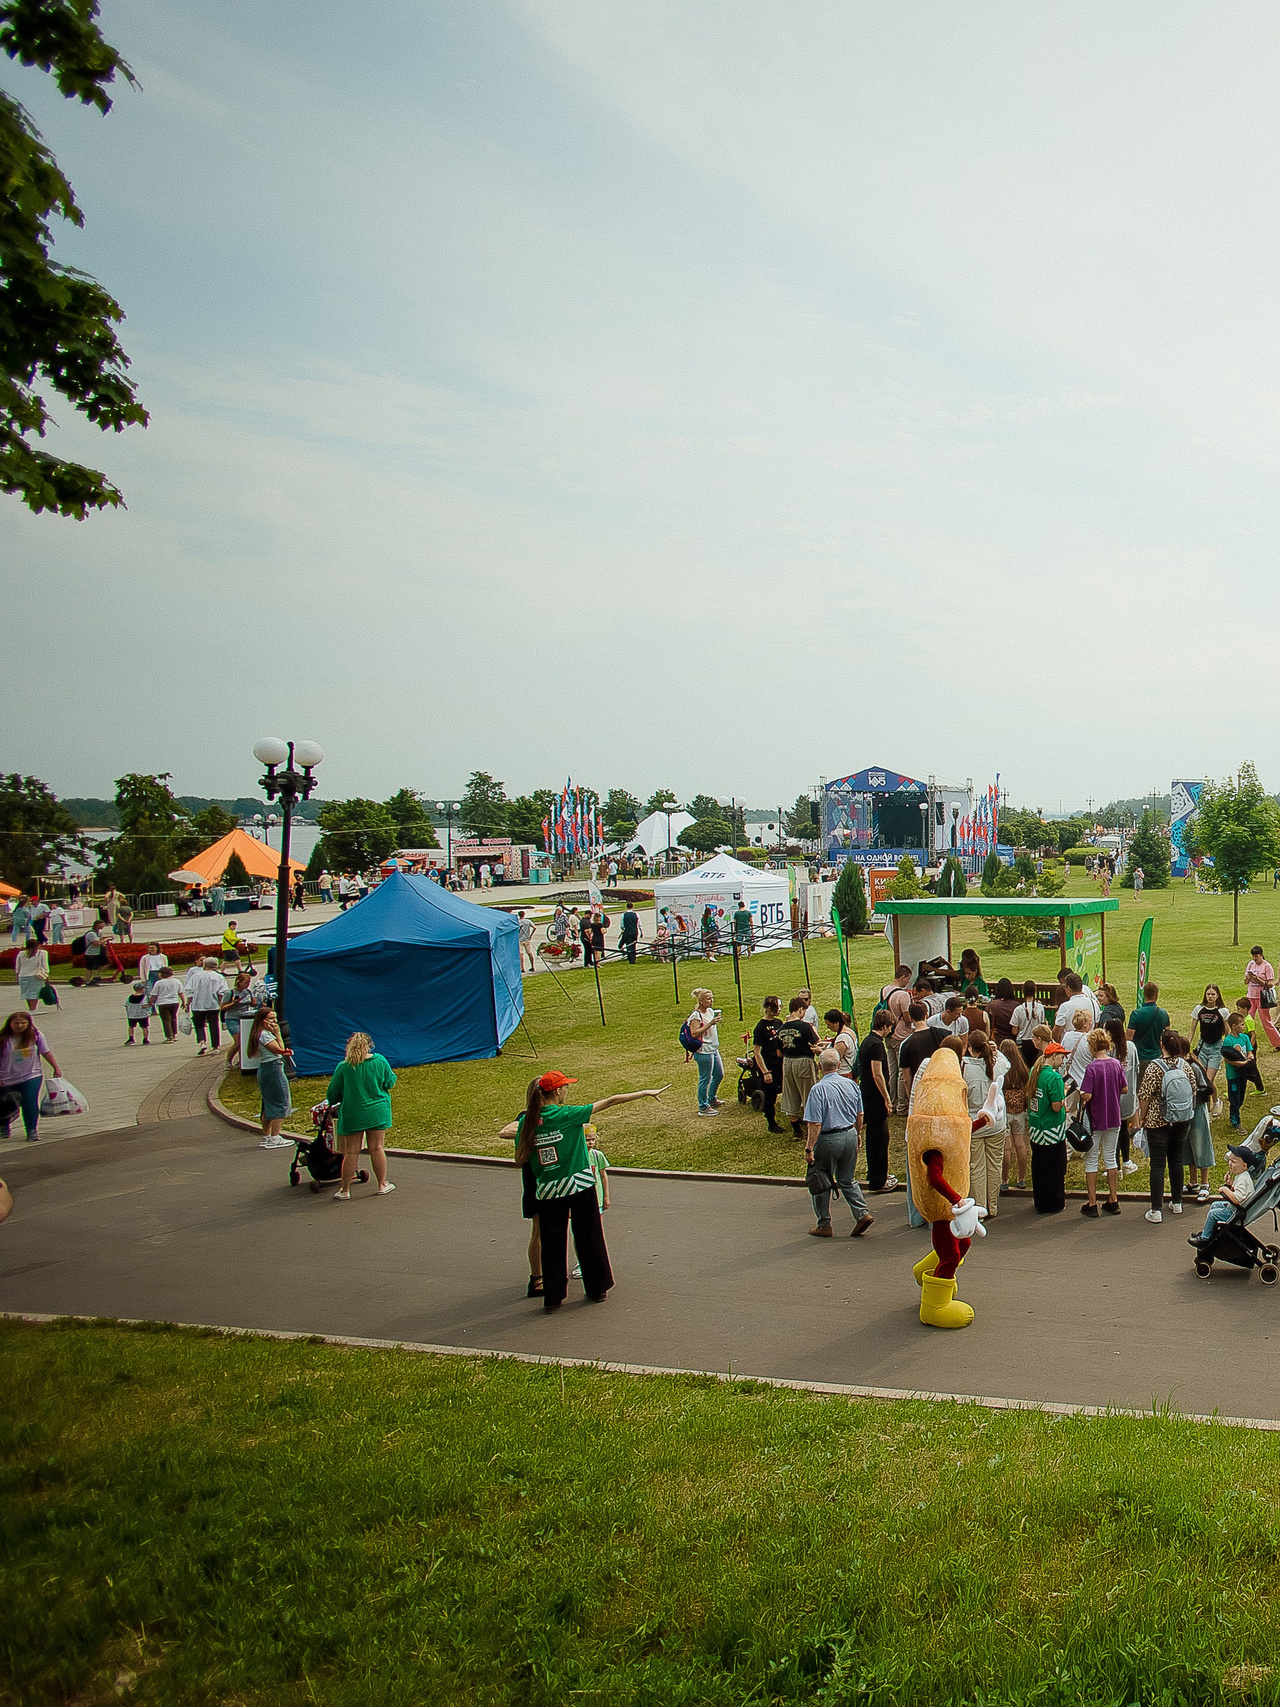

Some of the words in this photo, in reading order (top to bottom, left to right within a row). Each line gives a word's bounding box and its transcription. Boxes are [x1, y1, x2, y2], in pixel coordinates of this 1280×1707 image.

[866, 853, 893, 861] ОДНОЙ
[700, 871, 727, 879] ВТБ
[760, 902, 784, 924] ВТБ
